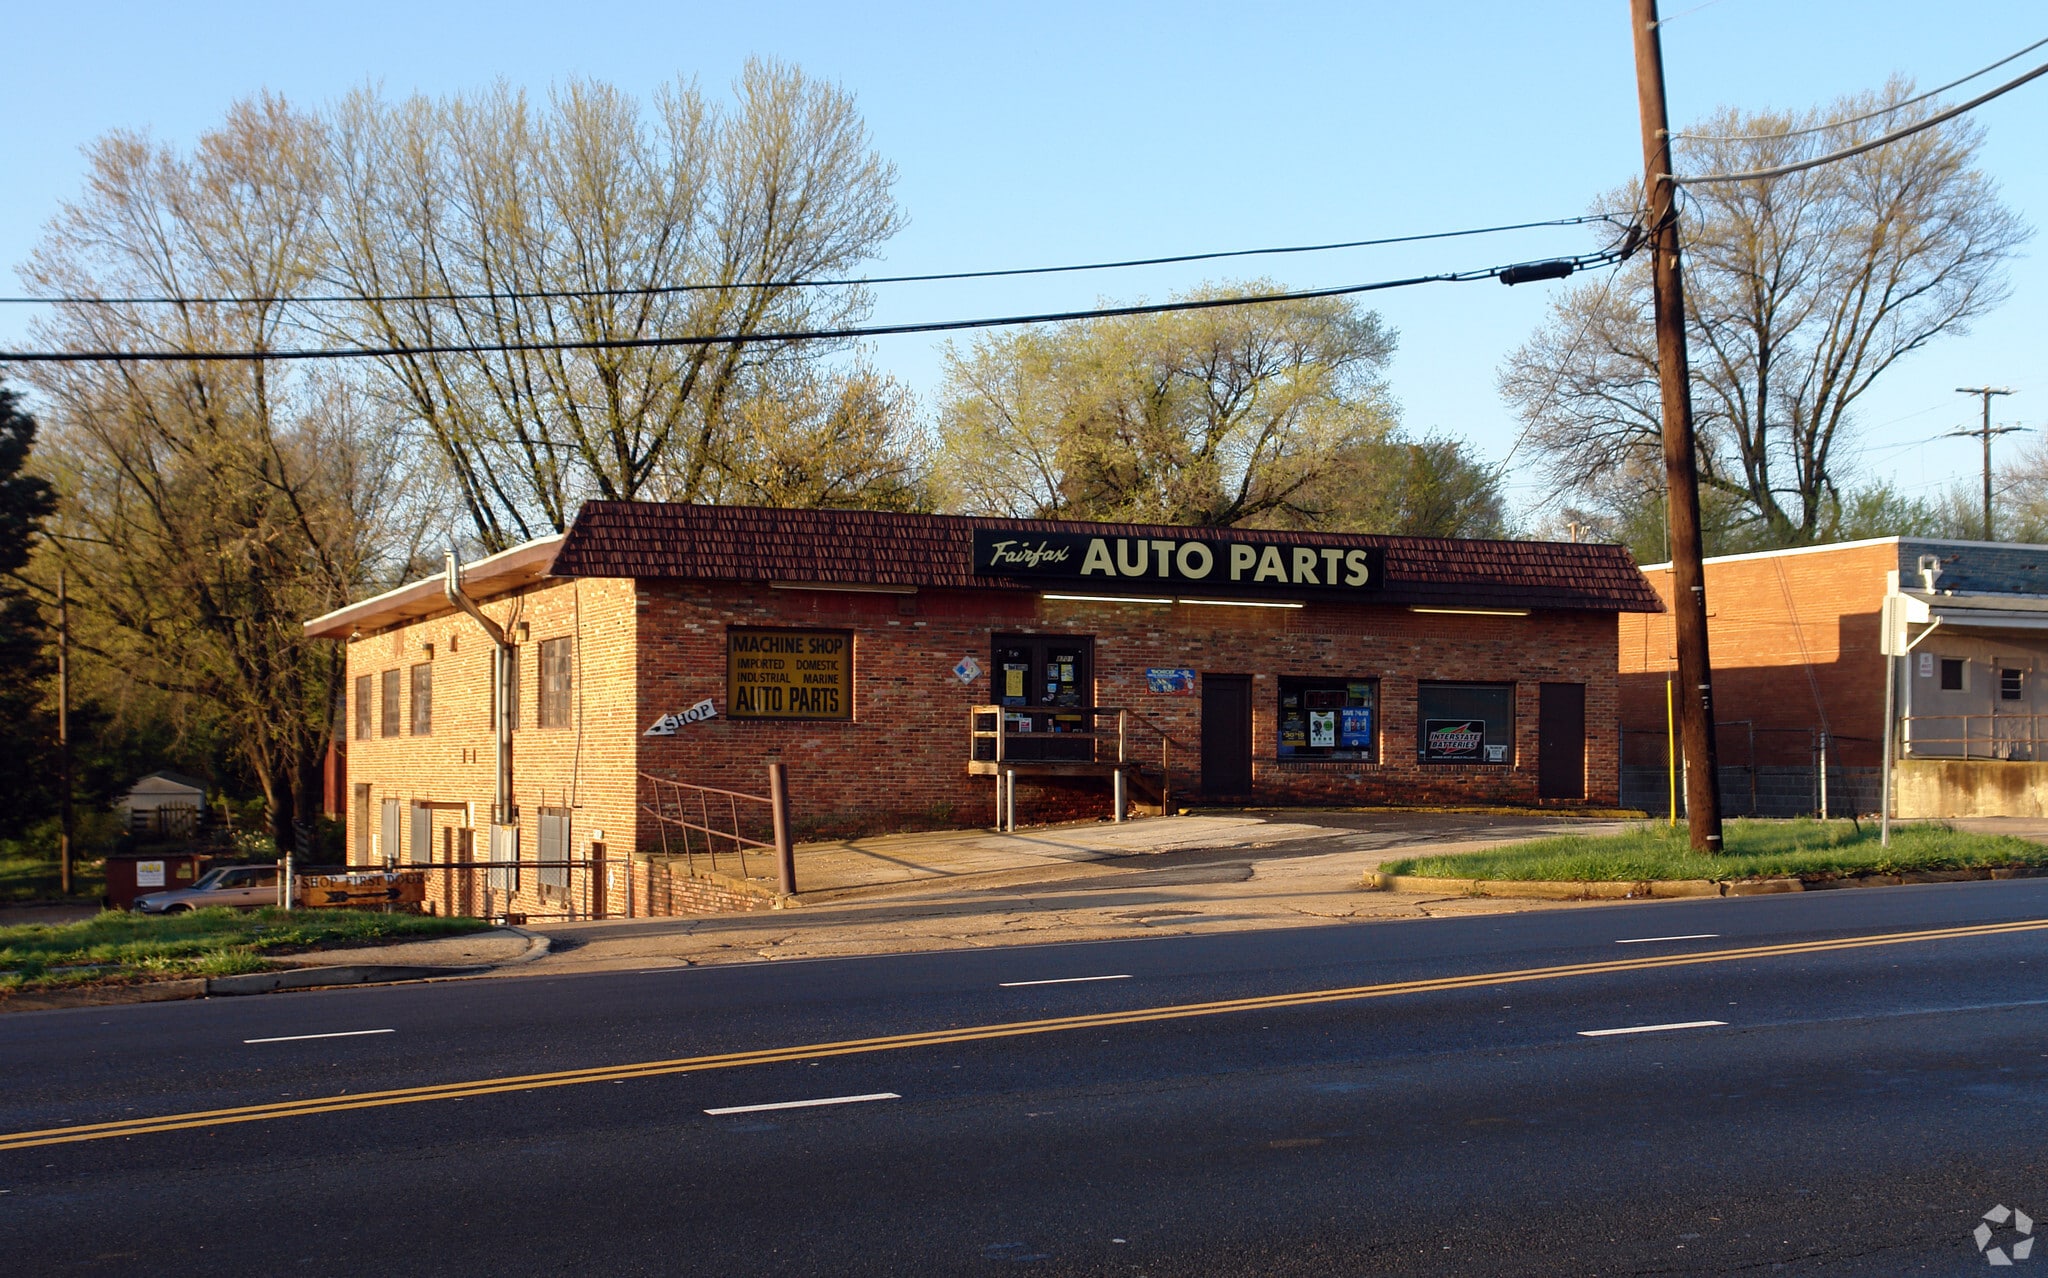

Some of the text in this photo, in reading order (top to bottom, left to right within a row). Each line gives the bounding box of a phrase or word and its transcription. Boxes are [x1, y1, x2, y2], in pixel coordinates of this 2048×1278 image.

[989, 538, 1370, 587] Fairfax AUTO PARTS
[733, 636, 843, 655] MACHINE SHOP
[737, 658, 839, 671] IMPORTED DOMESTIC
[737, 672, 839, 684] INDUSTRIAL MARINE
[736, 686, 839, 713] AUTO PARTS
[663, 703, 711, 732] SHOP
[1431, 733, 1479, 741] INTERSTATE
[301, 877, 338, 889] SHOP
[345, 875, 382, 887] FIRST
